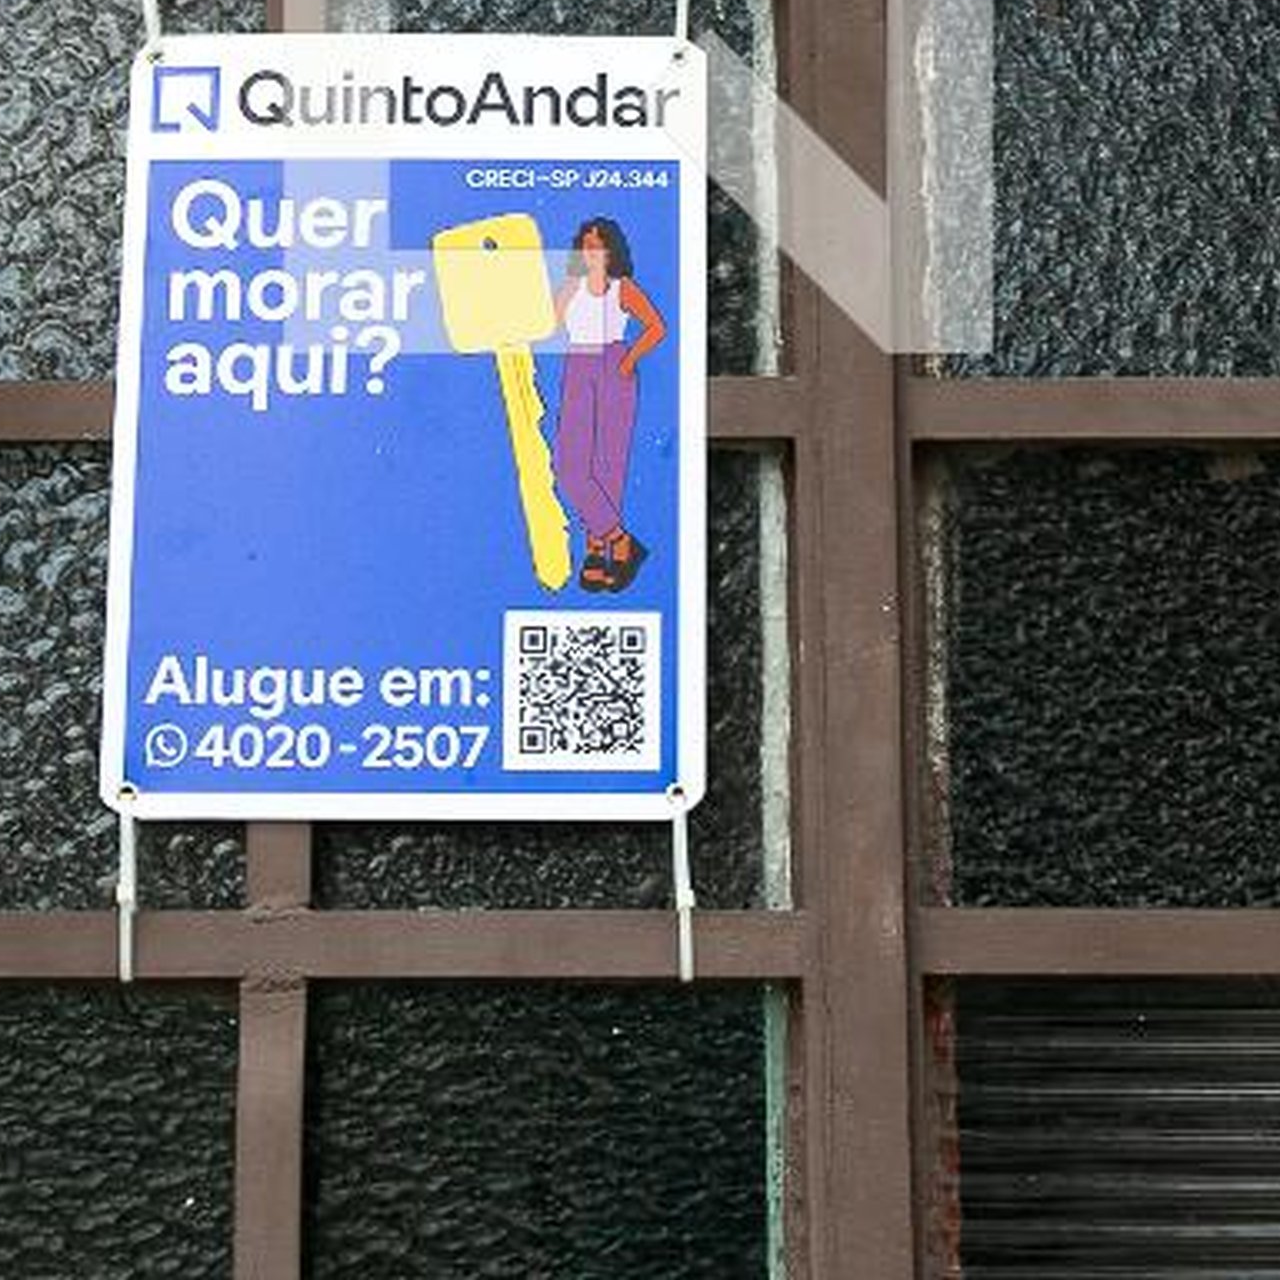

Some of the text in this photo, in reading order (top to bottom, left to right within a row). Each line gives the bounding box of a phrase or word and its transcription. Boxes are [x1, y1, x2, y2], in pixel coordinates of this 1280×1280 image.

[238, 70, 680, 129] QuintoAndar
[582, 169, 669, 189] J24.344
[171, 179, 387, 250] Quer
[168, 267, 425, 322] morar
[164, 326, 402, 412] aqui?
[145, 656, 492, 719] Alugue em:
